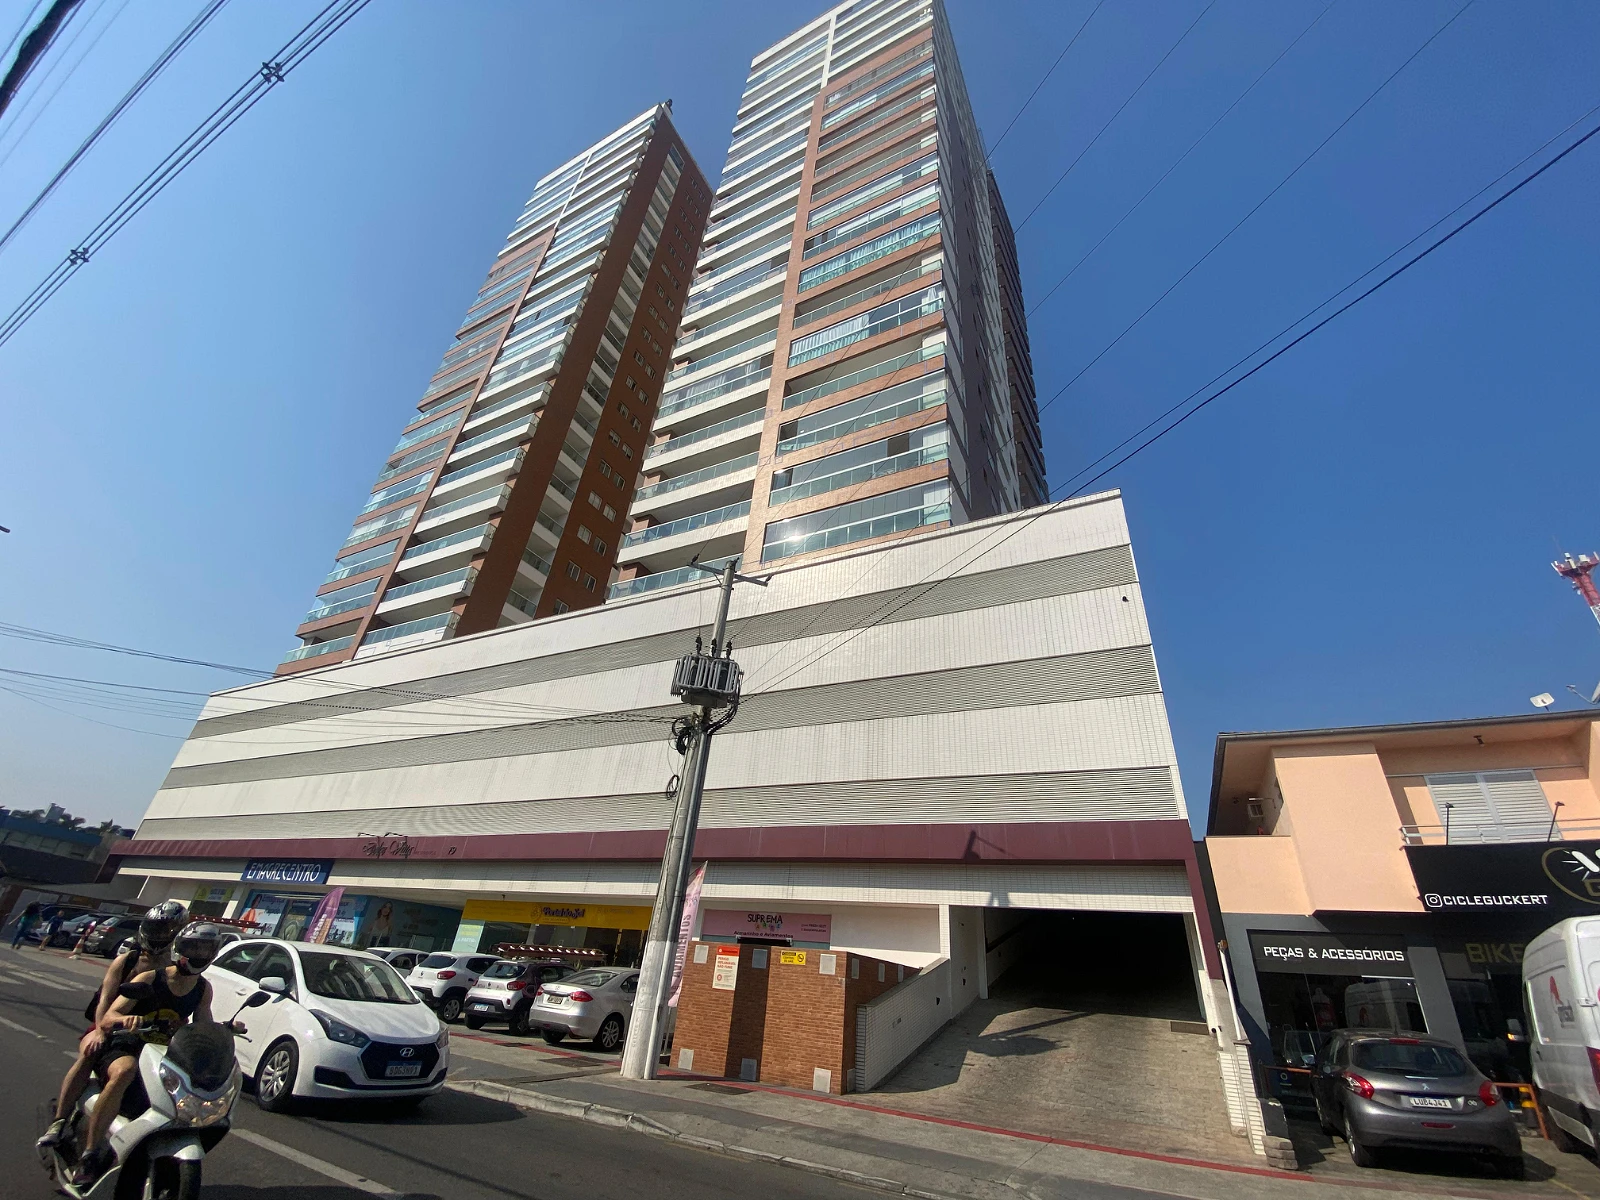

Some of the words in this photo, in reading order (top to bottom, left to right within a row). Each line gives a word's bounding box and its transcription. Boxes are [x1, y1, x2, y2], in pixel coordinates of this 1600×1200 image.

[246, 862, 322, 882] EMAGRECENTRO
[1443, 894, 1548, 905] CICLEGUCKERT
[747, 914, 783, 924] SUPREMA
[672, 914, 691, 978] AVIAMENTOS
[1264, 946, 1303, 961] PEÇAS
[1308, 949, 1318, 958] &
[1322, 947, 1405, 961] ACESSÓRIOS
